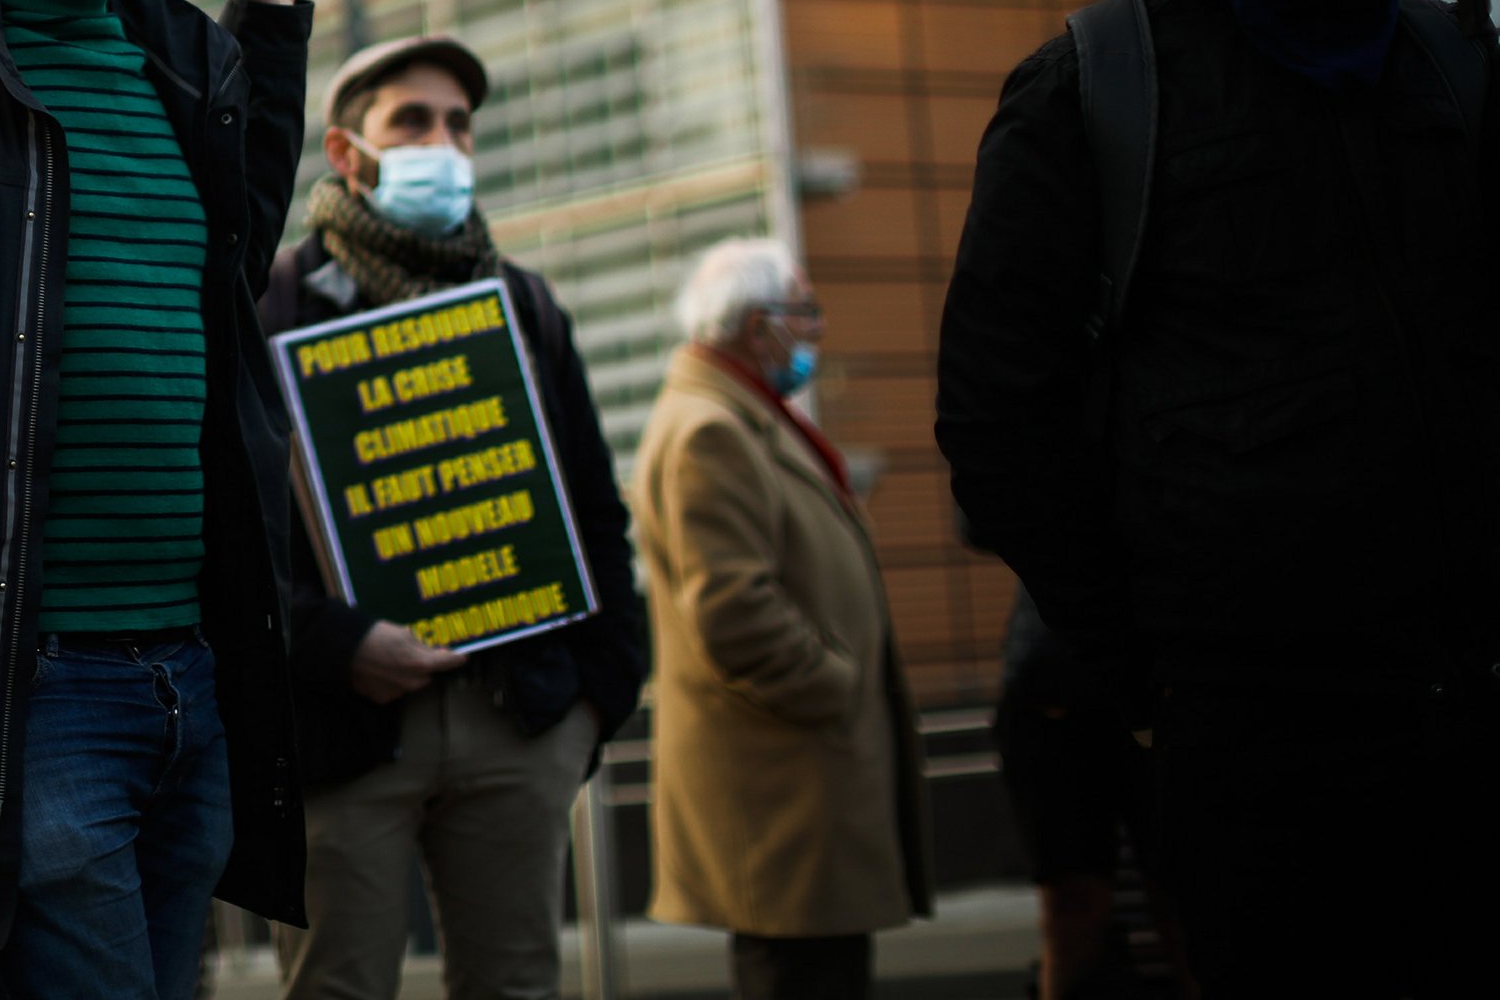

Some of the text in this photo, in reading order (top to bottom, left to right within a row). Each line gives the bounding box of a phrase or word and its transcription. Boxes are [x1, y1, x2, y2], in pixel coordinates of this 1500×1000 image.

[299, 297, 505, 376] POUR RESOUDRE
[359, 356, 471, 411] LA CRISE
[353, 395, 509, 464] CLIMATIQUE
[346, 439, 537, 516] IL FAUT PENSER
[374, 489, 535, 559] UN NOUVEAU
[416, 544, 521, 600] MODELE
[409, 583, 569, 650] CONOMIQUE
